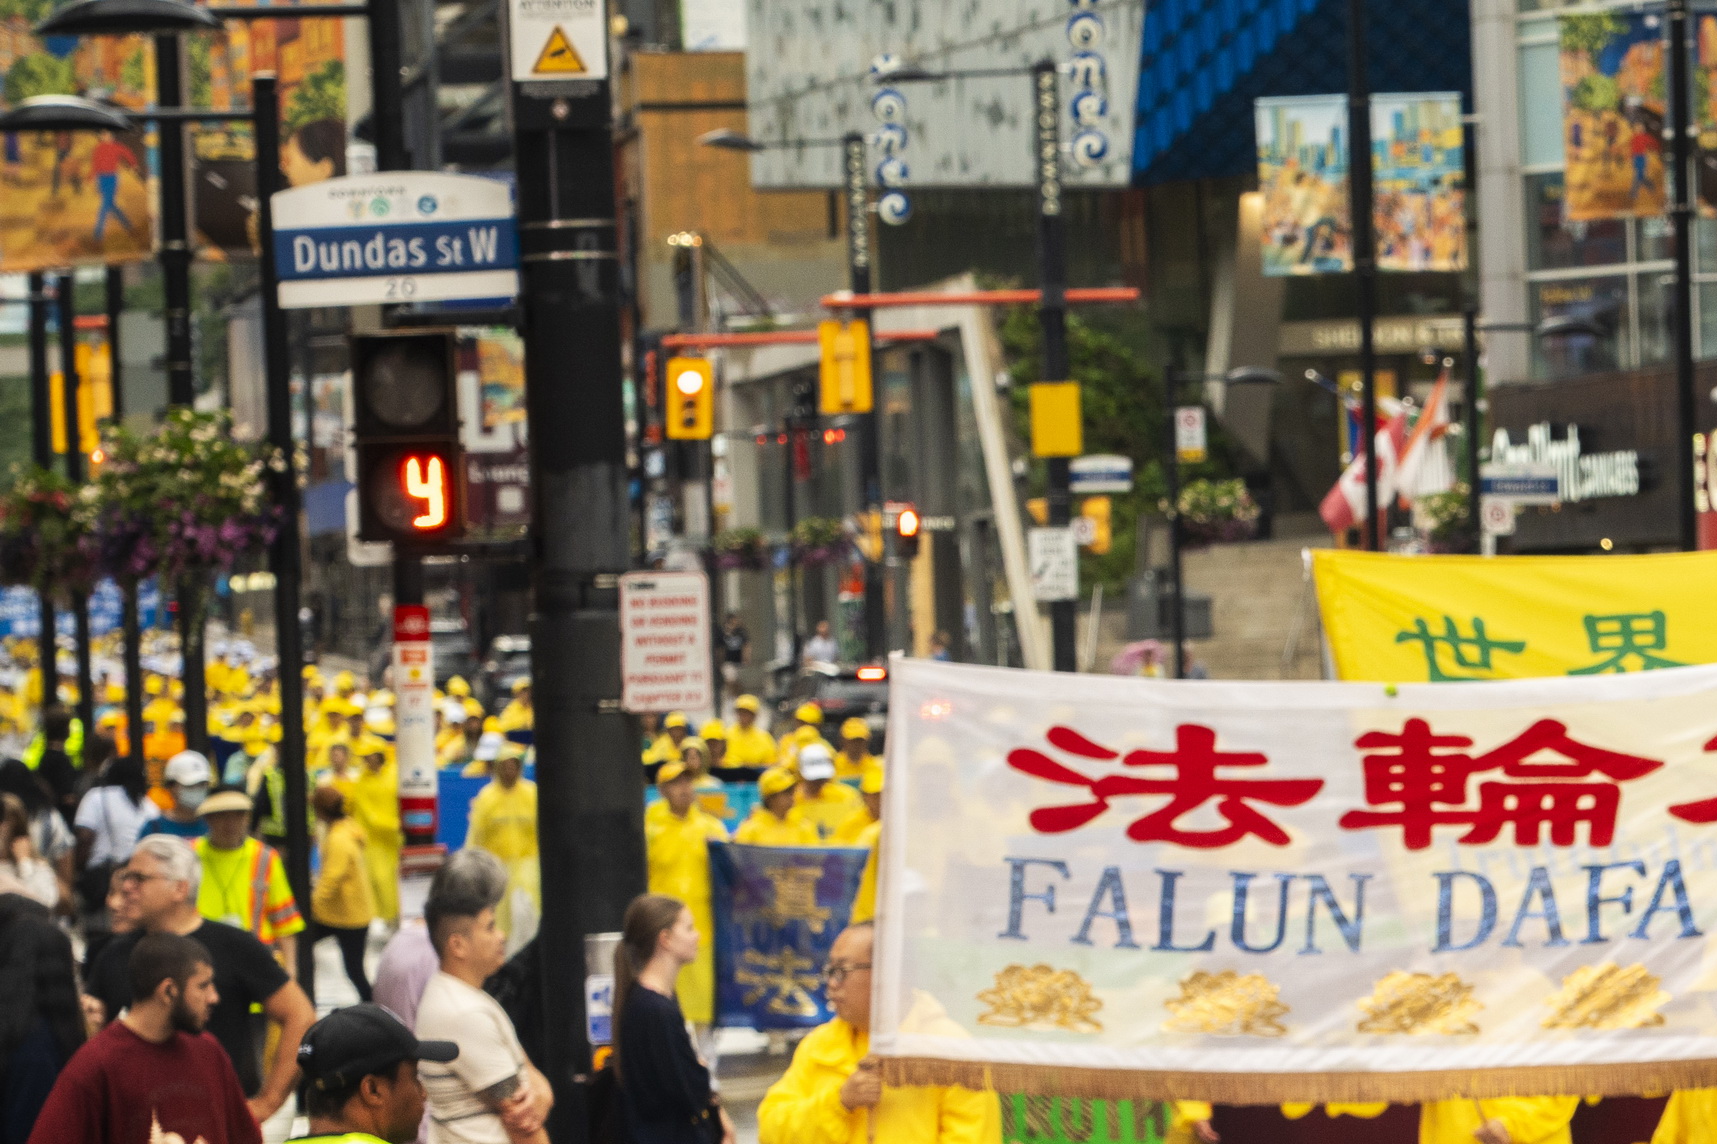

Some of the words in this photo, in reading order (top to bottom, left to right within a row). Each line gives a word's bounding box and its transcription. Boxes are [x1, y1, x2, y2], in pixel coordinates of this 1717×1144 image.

[292, 231, 428, 274] Dundas
[435, 235, 465, 266] St
[468, 226, 498, 264] W
[385, 277, 417, 297] 20
[997, 857, 1374, 955] FALUN
[1432, 858, 1704, 954] DAFA
